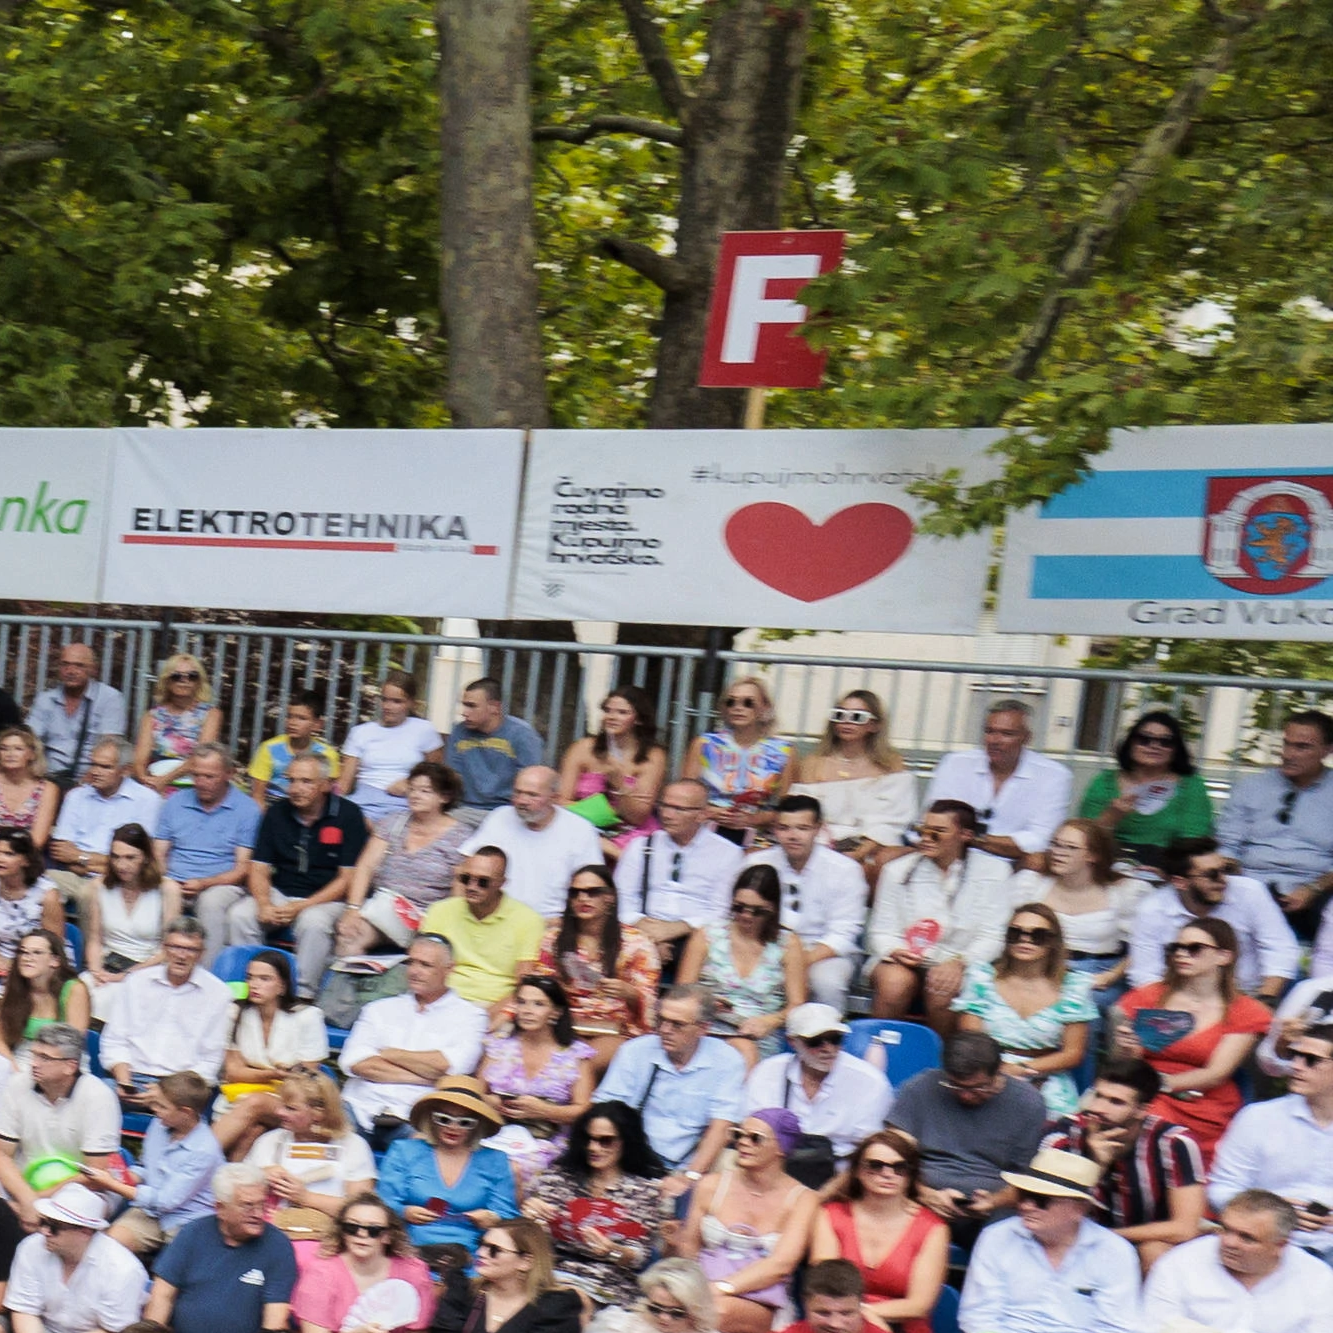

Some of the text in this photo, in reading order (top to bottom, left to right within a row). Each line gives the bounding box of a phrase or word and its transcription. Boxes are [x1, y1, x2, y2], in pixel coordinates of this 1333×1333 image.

[720, 254, 822, 363] F
[132, 507, 470, 541] ELEKTROTEHNIKA
[1128, 600, 1228, 625] Grad
